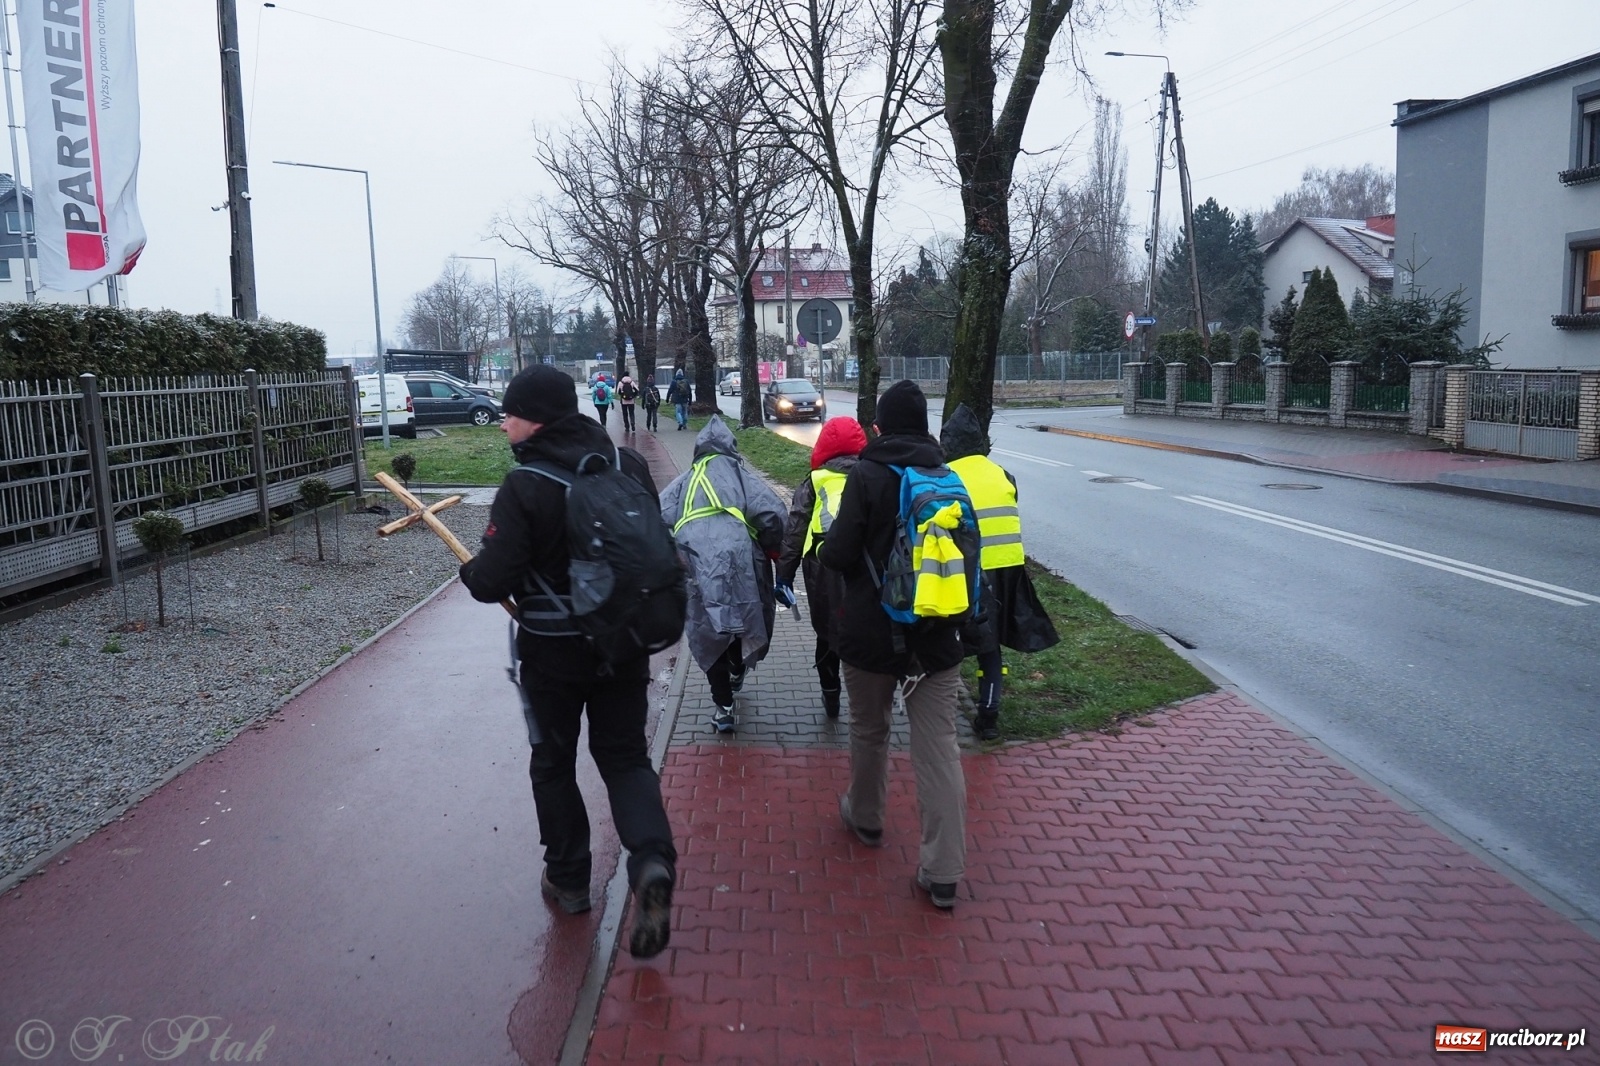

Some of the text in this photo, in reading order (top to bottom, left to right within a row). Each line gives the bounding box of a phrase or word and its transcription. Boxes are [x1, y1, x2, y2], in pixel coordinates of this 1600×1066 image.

[97, 37, 110, 71] poziom
[101, 73, 111, 110] Wyższy
[43, 0, 100, 233] PARTNER
